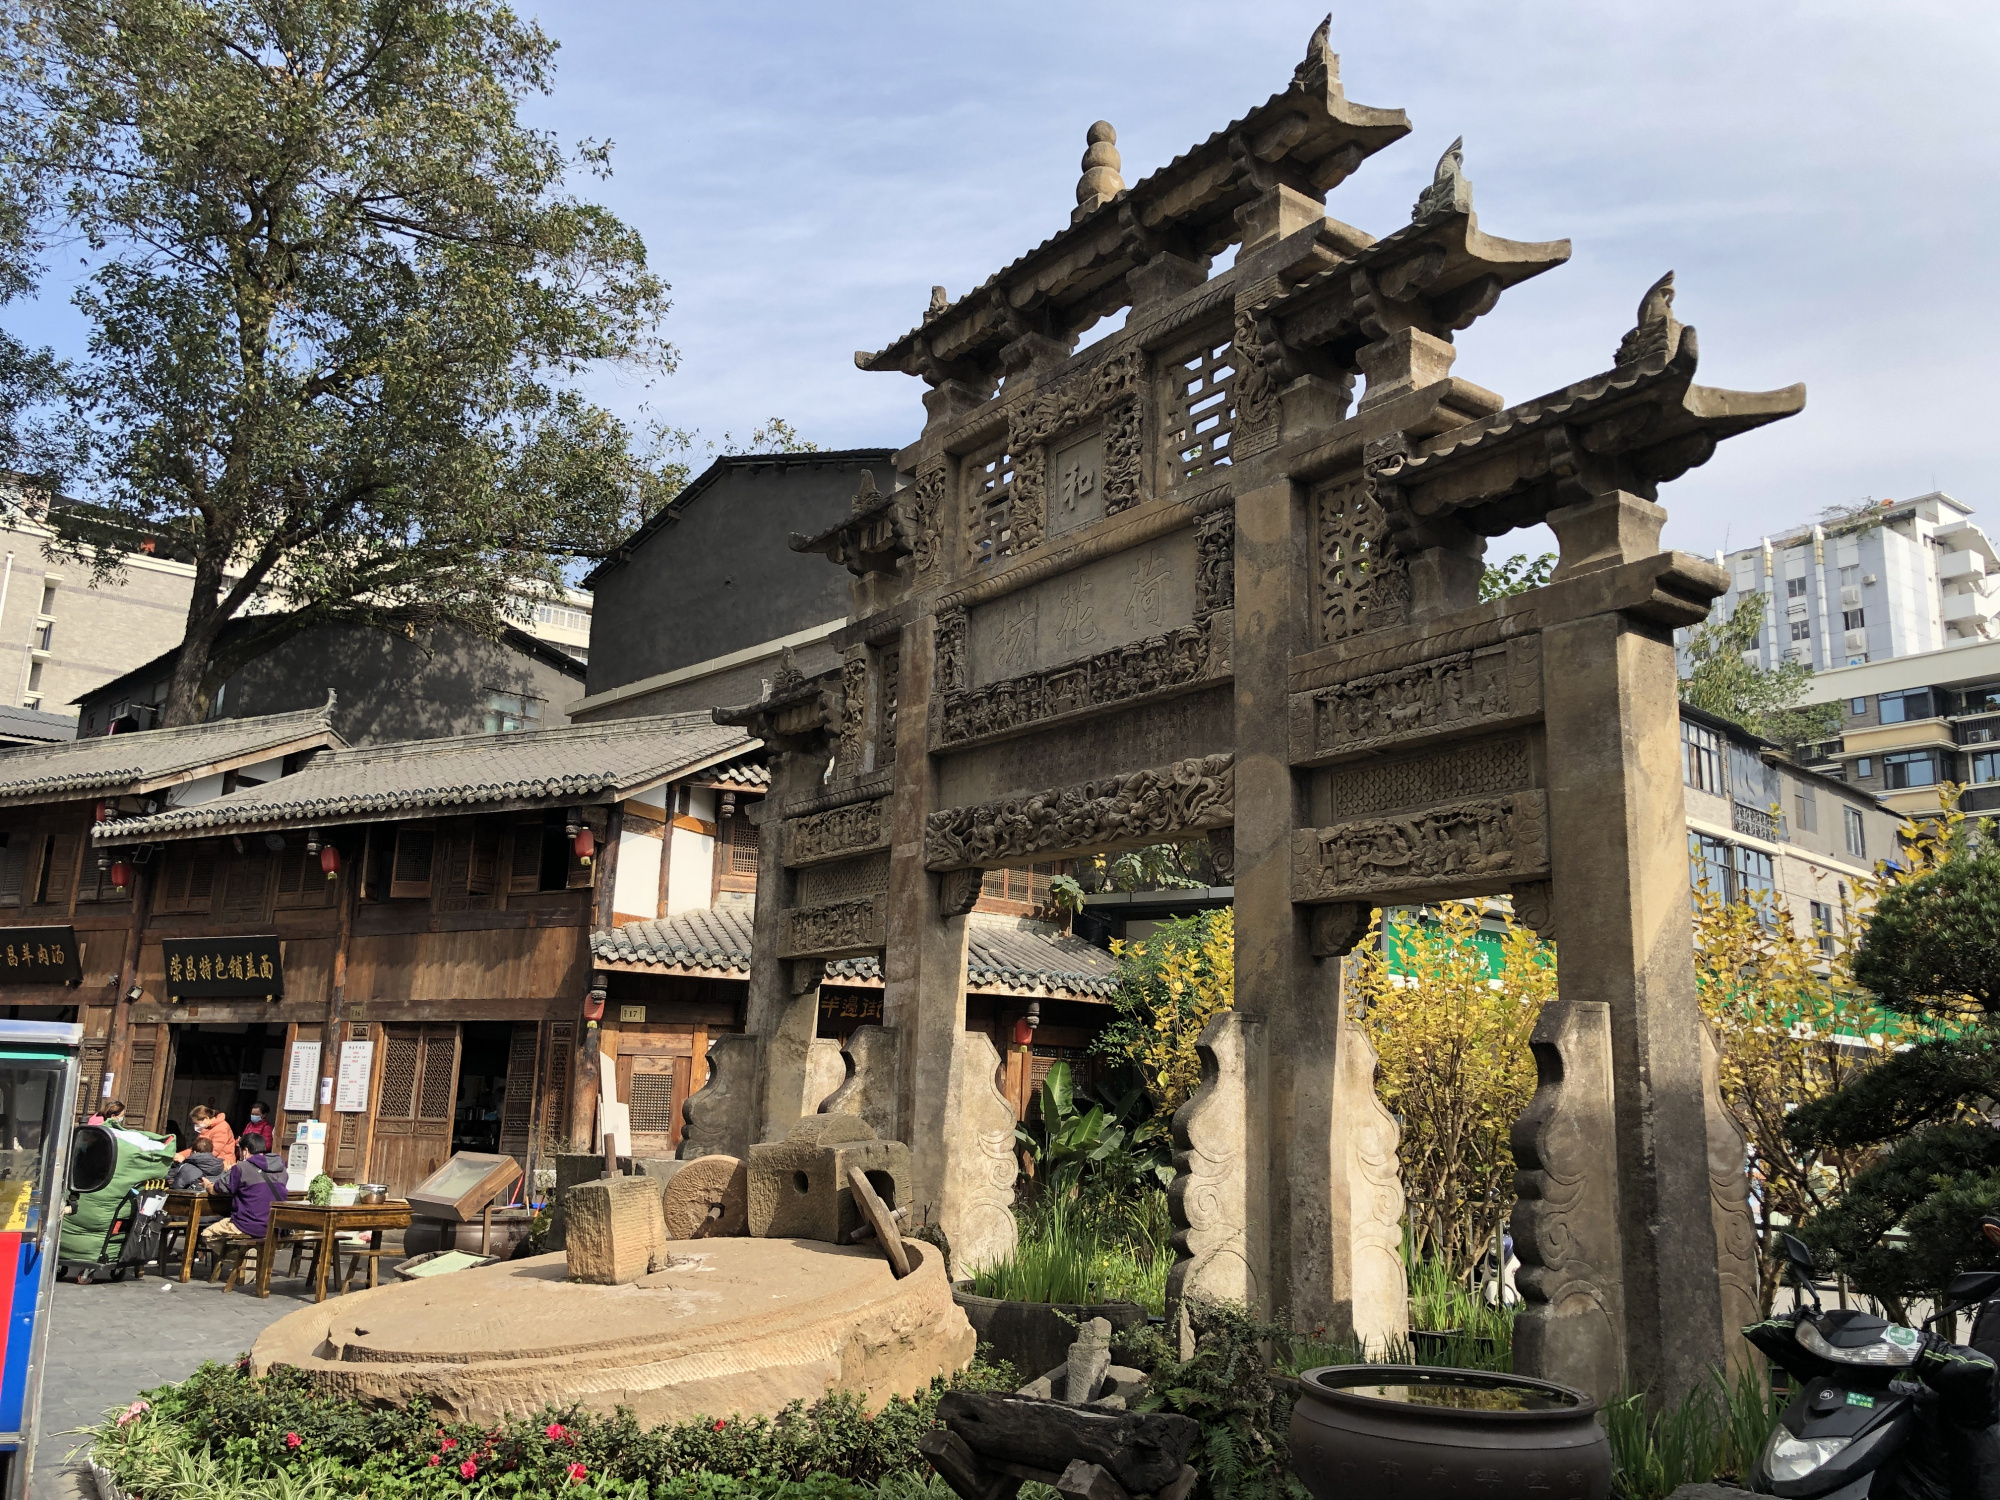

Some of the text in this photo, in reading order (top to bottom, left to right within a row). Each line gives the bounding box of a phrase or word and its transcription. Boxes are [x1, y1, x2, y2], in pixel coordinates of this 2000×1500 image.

[1063, 460, 1095, 511] 和
[0, 942, 65, 968] 昌羊肉汤
[169, 951, 274, 983] 荣昌特色铺盖面
[628, 1010, 638, 1018] 17
